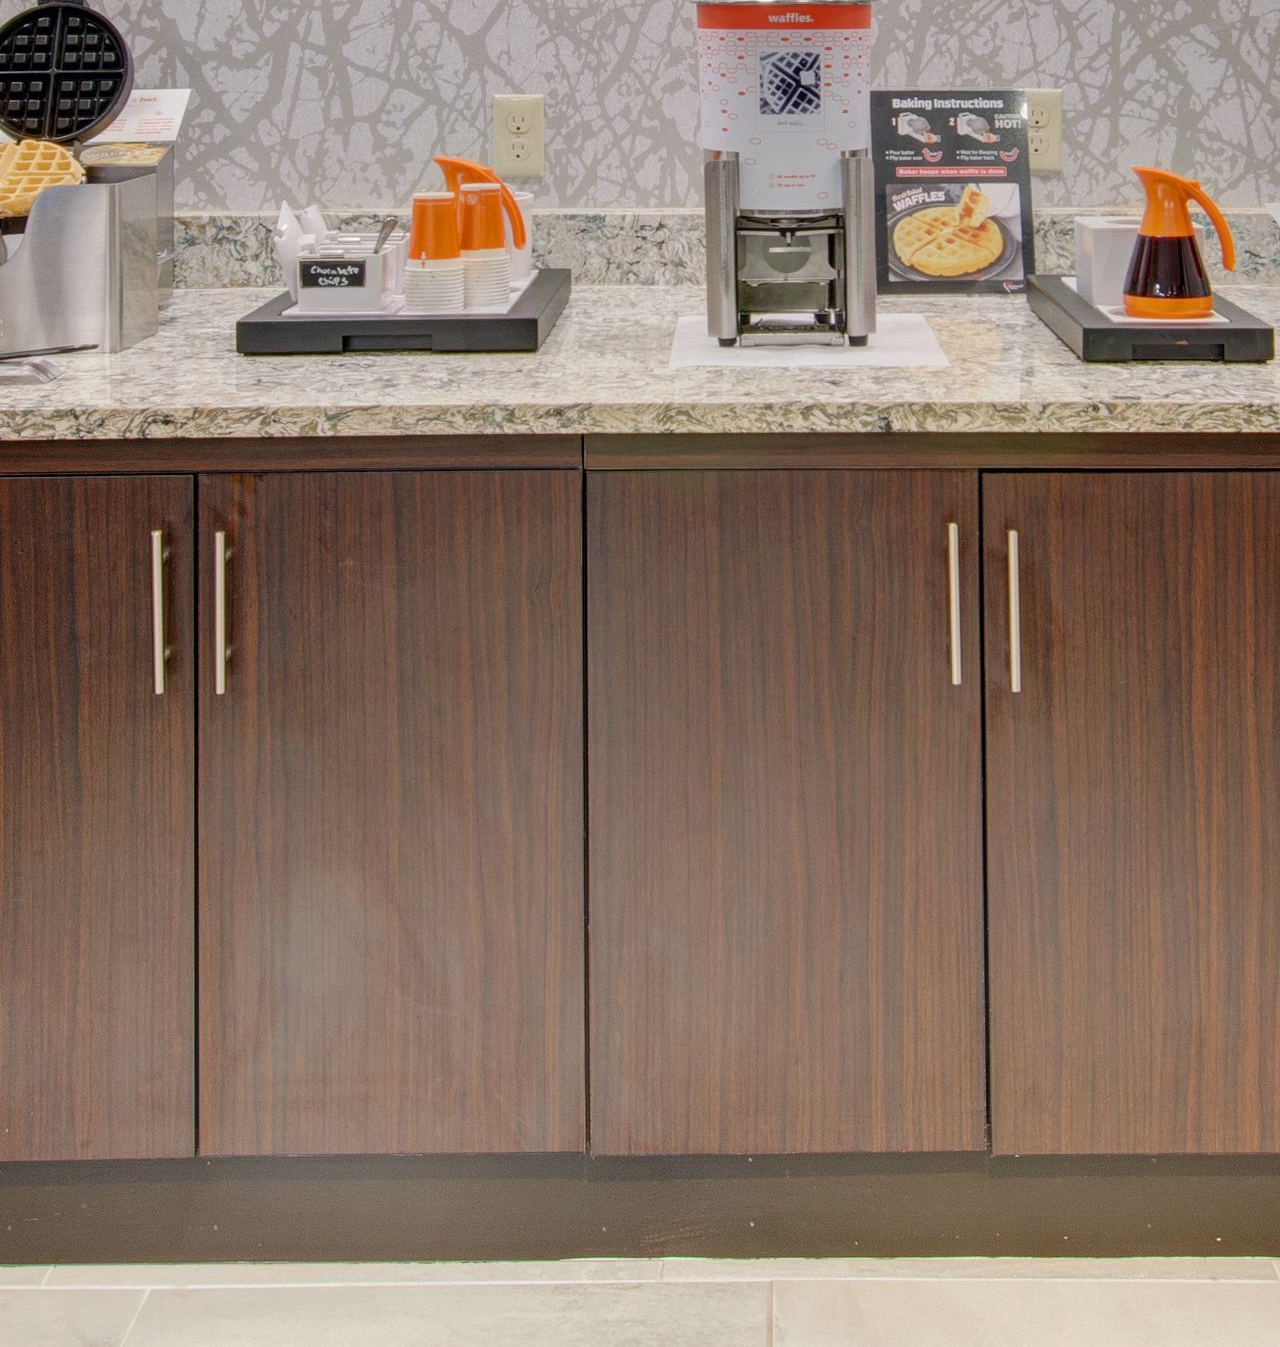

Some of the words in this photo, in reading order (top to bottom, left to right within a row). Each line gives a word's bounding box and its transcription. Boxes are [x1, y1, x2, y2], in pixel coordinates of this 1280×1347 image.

[768, 12, 814, 23] waffles.
[892, 97, 932, 110] Baking
[934, 97, 1004, 109] Instructions
[891, 117, 896, 126] 1
[949, 117, 956, 126] 2
[995, 119, 1021, 129] HOT!
[892, 191, 946, 211] WAFFLES
